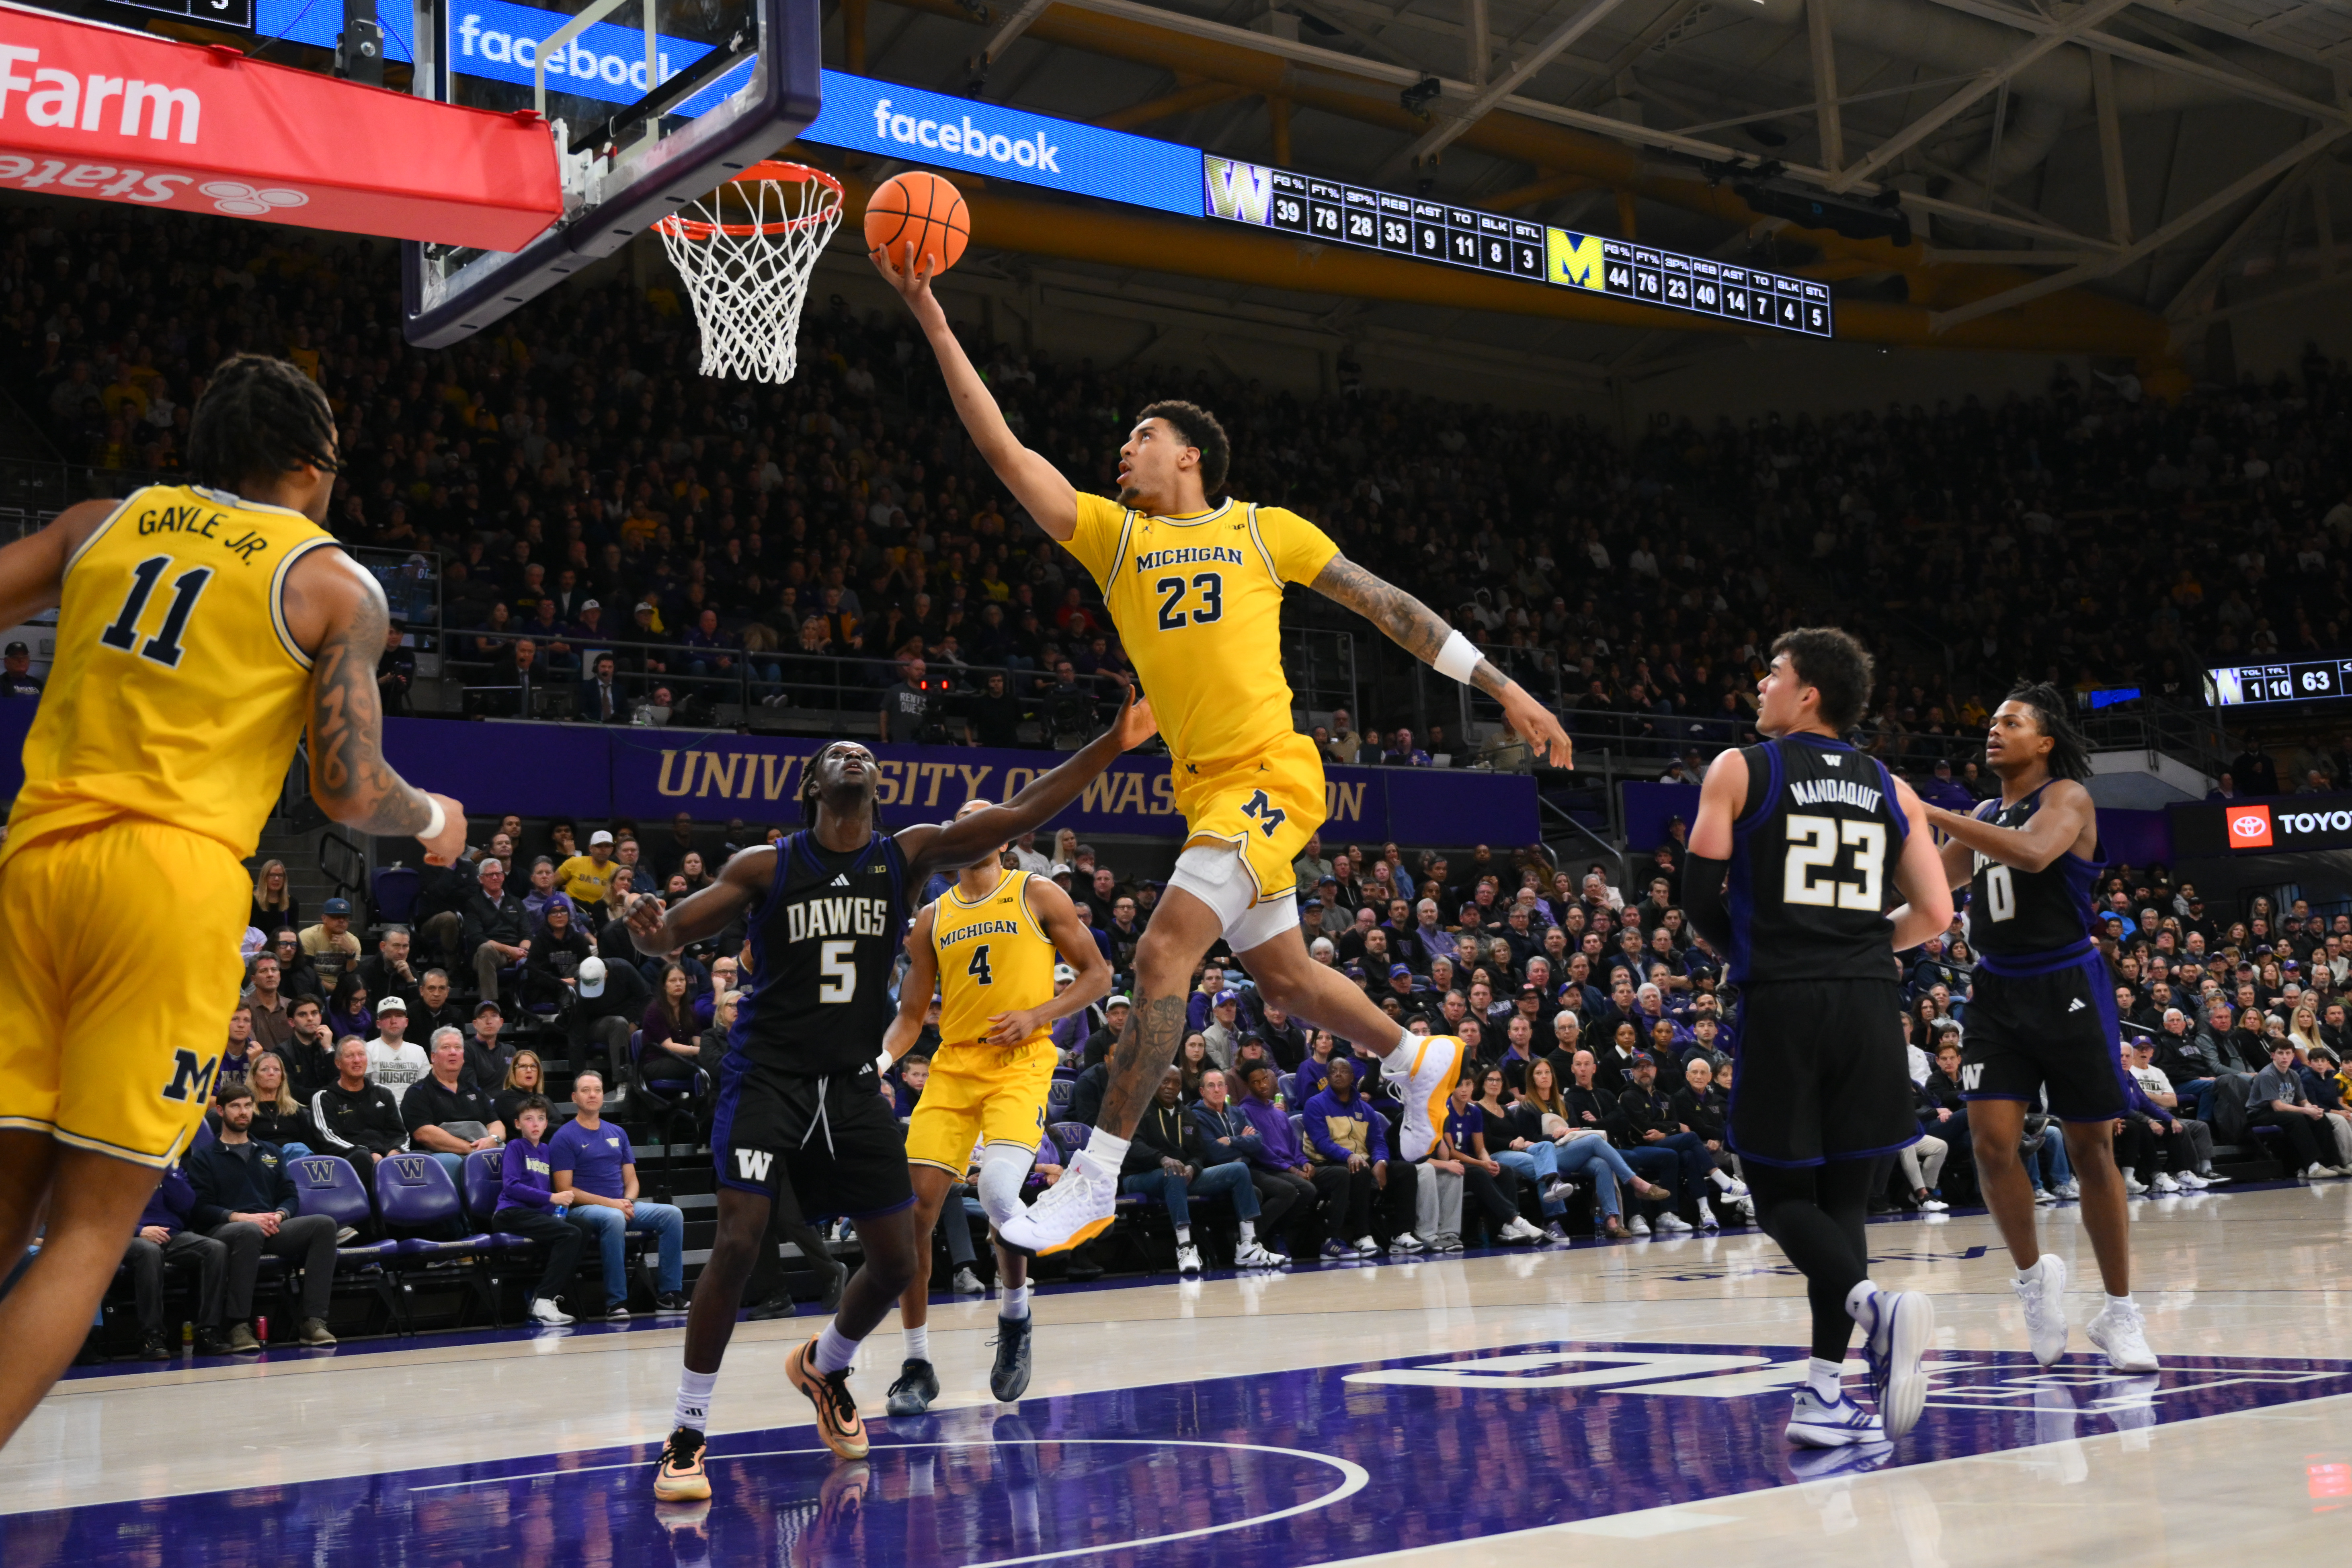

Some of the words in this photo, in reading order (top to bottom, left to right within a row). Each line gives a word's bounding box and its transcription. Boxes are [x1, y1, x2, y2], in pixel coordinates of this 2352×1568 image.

[459, 14, 682, 91] facebook
[0, 43, 201, 145] Farm
[874, 99, 1060, 173] facebook
[1311, 183, 1340, 199] FT%
[1346, 191, 1376, 206] 3P%
[1381, 197, 1409, 211] REB
[1415, 204, 1442, 218] AST
[1453, 211, 1472, 224] TO
[1482, 217, 1508, 232] BLK
[1515, 224, 1540, 238] STL
[1277, 200, 1300, 222] 39
[1315, 207, 1338, 230] 78
[1350, 215, 1373, 237] 28
[1385, 221, 1407, 244] 33
[1423, 229, 1436, 250] 9
[1456, 236, 1474, 257] 11
[1491, 242, 1503, 262] 8
[1522, 249, 1534, 269] 3
[1548, 228, 1604, 290] M
[1636, 251, 1661, 264] FT%
[1665, 258, 1689, 271] 3P%
[1694, 262, 1717, 275] REB
[1722, 268, 1745, 281] AST
[1753, 275, 1770, 286] TO
[1777, 279, 1800, 293] BLK
[1805, 286, 1826, 298] STL
[1609, 267, 1629, 288] 44
[1638, 272, 1658, 293] 76
[1668, 278, 1688, 299] 23
[1696, 284, 1716, 305] 40
[1727, 291, 1745, 311] 14
[1757, 297, 1768, 315] 7
[1784, 303, 1795, 321] 4
[1812, 308, 1822, 326] 5
[139, 505, 229, 539] GAYLE
[224, 530, 268, 566] JR.
[1136, 545, 1244, 574] MICHIGAN
[100, 553, 216, 670] 11
[1156, 572, 1224, 632] 23
[2251, 682, 2260, 698] 1
[2270, 680, 2292, 697] 10
[2302, 671, 2330, 691] 63
[657, 750, 993, 808] UNIVSITY
[1821, 754, 1842, 767] W
[1241, 789, 1286, 838] M
[1790, 779, 1883, 813] MANDAQUIT
[2278, 810, 2352, 834] TOYO
[1783, 814, 1886, 912] 23
[997, 896, 1013, 905] B1G
[1987, 865, 2015, 923] 0
[787, 897, 887, 943] DAWGS
[939, 920, 1019, 951] MICHIGAN
[819, 939, 857, 1004] 5
[968, 944, 993, 985] 4
[162, 1047, 219, 1105] M
[379, 1061, 418, 1070] WASHINGTON
[379, 1071, 418, 1084] HUSKIES
[1962, 1063, 1985, 1090] W
[1051, 1083, 1070, 1100] W
[1058, 1125, 1082, 1143] W
[302, 1160, 335, 1182] W
[394, 1158, 425, 1179] W
[735, 1148, 774, 1182] W
[340, 1246, 381, 1254] WASHINGTON
